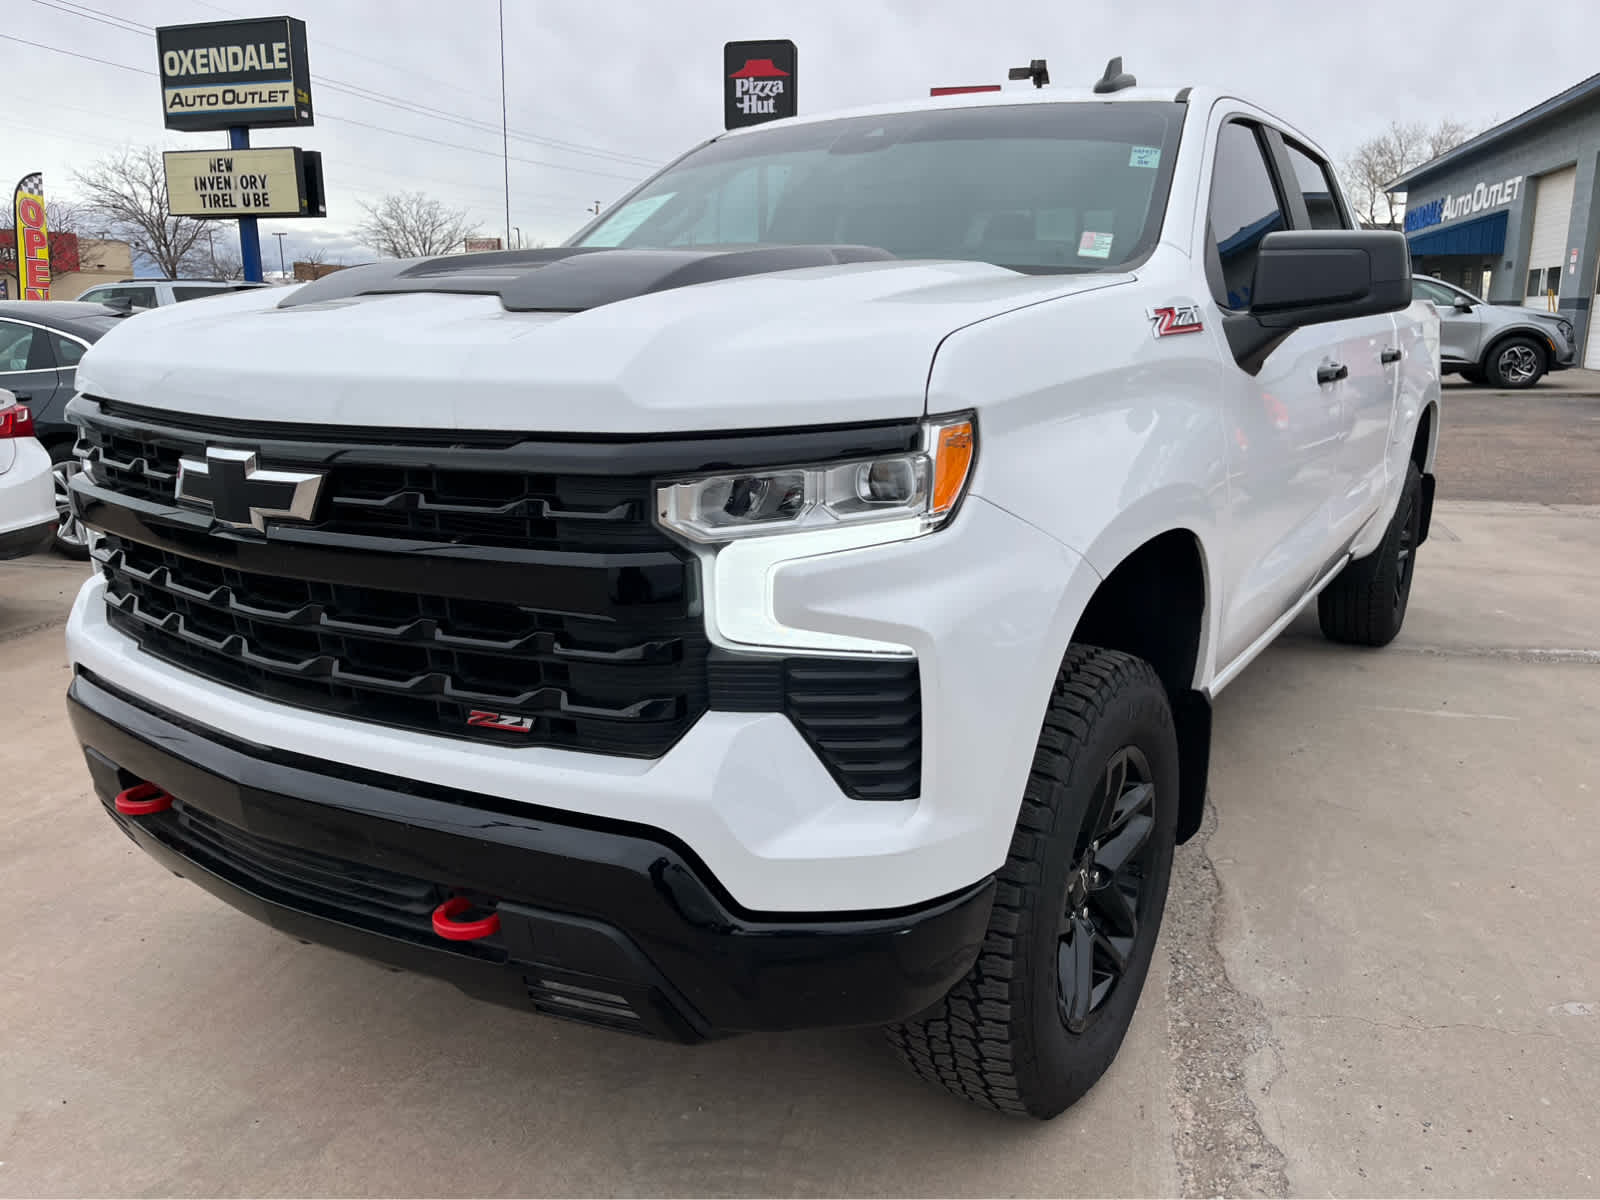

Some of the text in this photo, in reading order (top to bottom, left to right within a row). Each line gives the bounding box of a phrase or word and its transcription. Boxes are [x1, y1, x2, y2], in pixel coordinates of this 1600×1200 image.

[163, 42, 288, 77] OXENDALE
[735, 77, 784, 98] Pizza
[169, 92, 219, 109] AUTO
[221, 89, 289, 105] OUTLET
[736, 94, 777, 114] Hut
[209, 157, 233, 174] NEW
[193, 174, 267, 192] INVENORY
